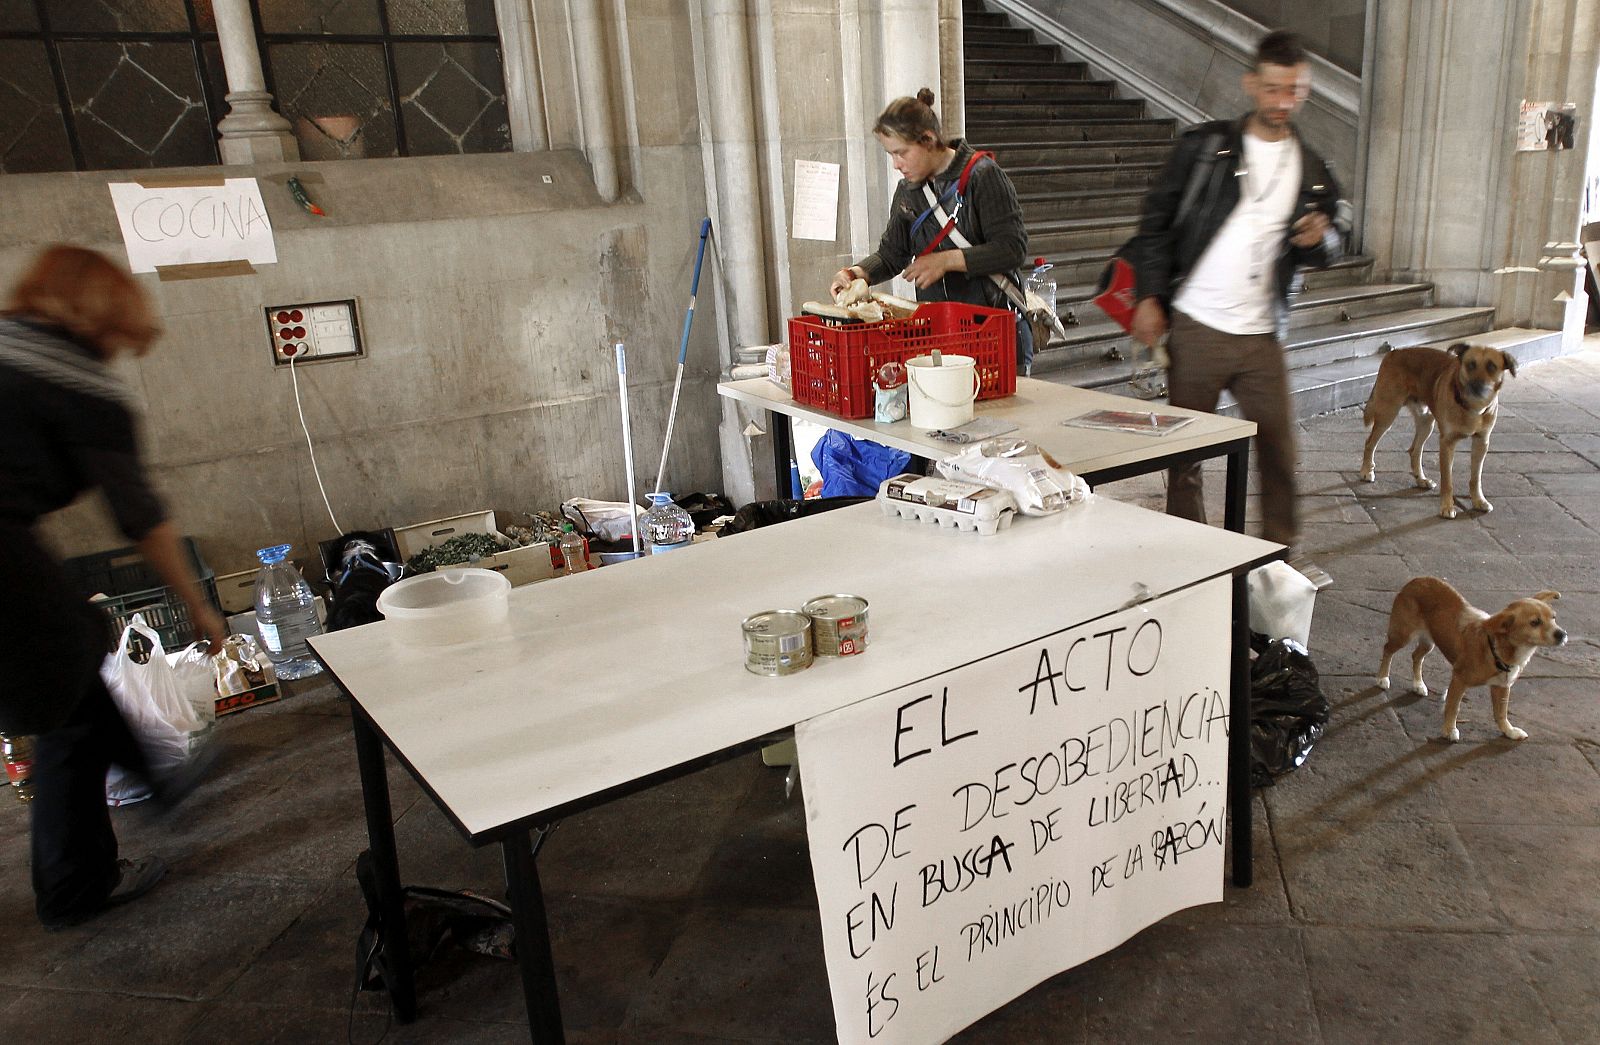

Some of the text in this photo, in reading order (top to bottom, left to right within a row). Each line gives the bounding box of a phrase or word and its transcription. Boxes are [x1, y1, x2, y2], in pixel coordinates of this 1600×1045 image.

[132, 194, 269, 243] COCINA
[893, 617, 1163, 768] EL ACTO
[843, 685, 1231, 890] DE DESOBEDIENCIA
[846, 881, 898, 960] EN
[919, 834, 1016, 908] BUSCA
[1030, 807, 1063, 856] DE
[916, 944, 945, 992] EL
[960, 876, 1071, 963] PRINCIPIO
[1091, 854, 1120, 897] DE
[1124, 843, 1144, 880] LA
[1151, 800, 1226, 873] RAZÓN
